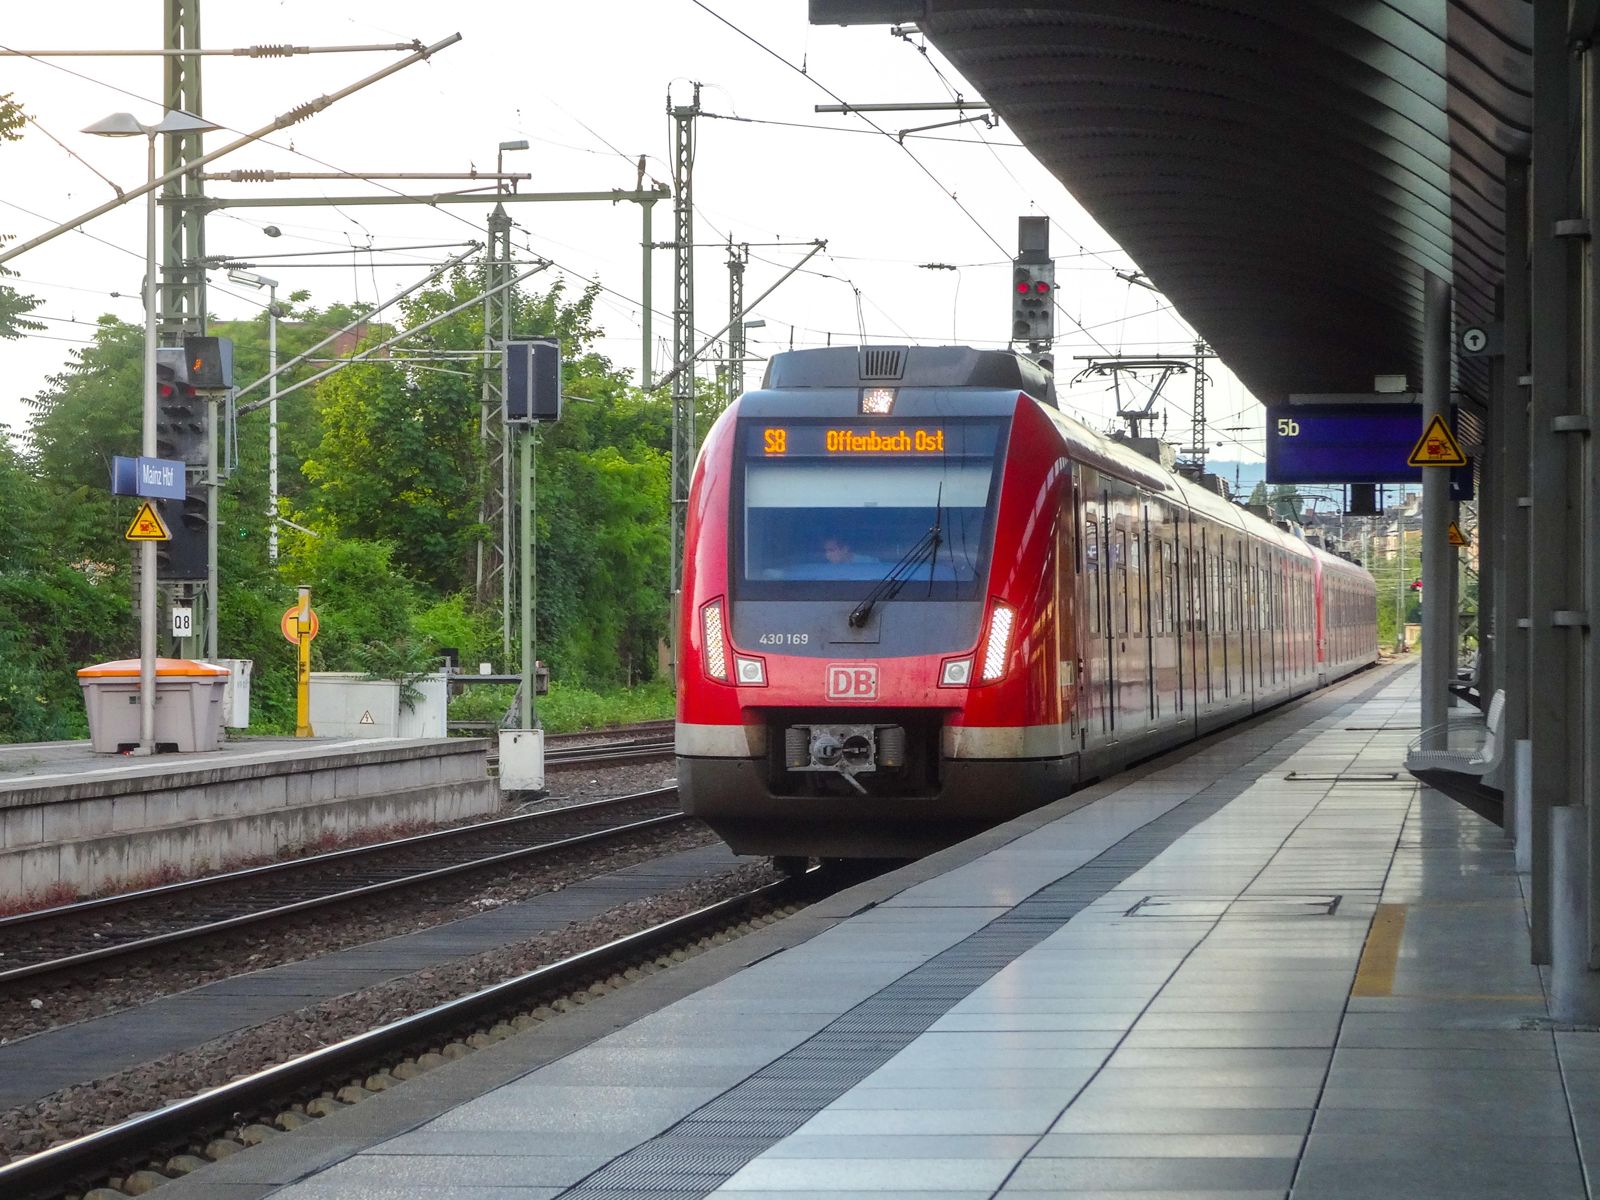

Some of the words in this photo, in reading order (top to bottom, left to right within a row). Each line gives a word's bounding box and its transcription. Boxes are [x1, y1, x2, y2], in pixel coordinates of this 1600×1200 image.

[1277, 418, 1300, 436] 5b
[764, 428, 786, 453] S8
[826, 429, 911, 451] Offenbach
[914, 429, 944, 451] Ost
[142, 463, 162, 485] Mainz
[162, 465, 174, 487] Hbf
[759, 633, 783, 645] 430
[786, 633, 809, 645] 169
[832, 669, 873, 695] DB
